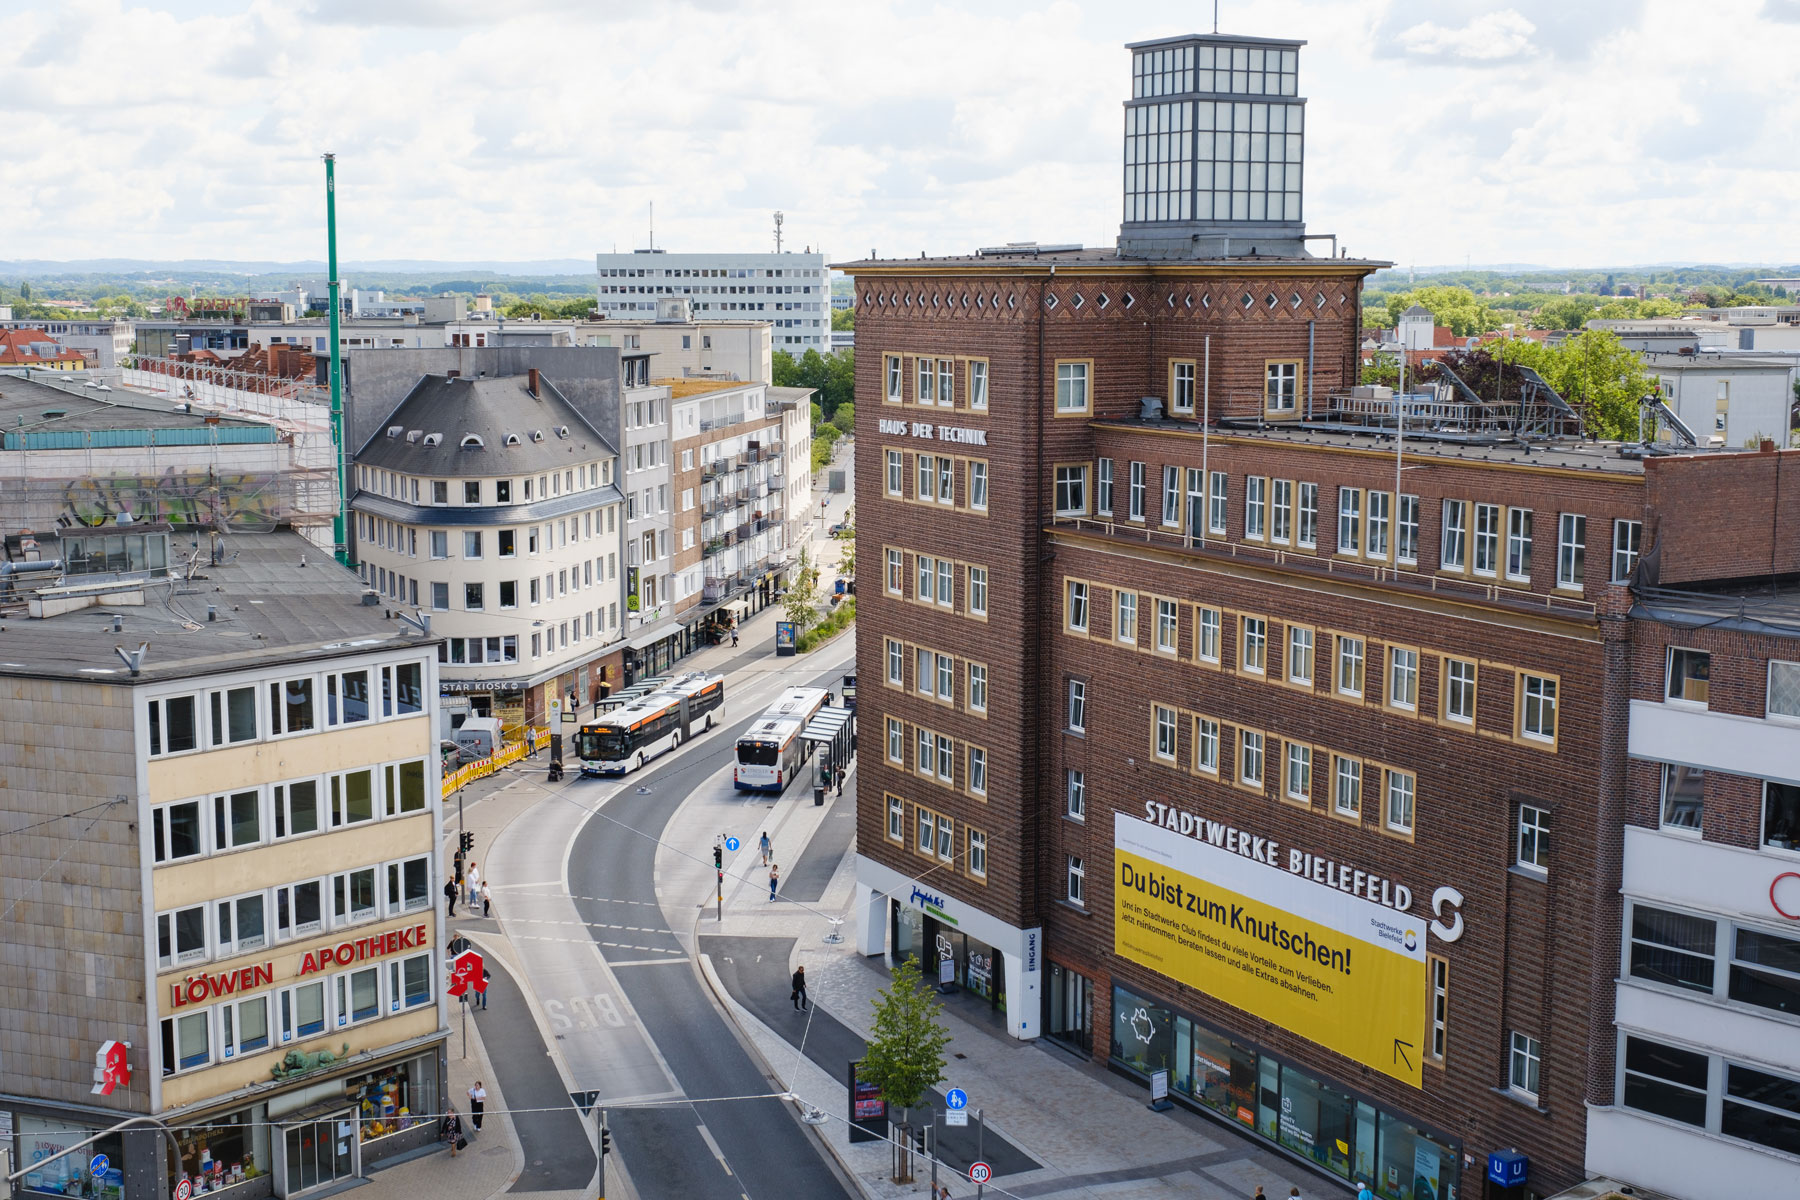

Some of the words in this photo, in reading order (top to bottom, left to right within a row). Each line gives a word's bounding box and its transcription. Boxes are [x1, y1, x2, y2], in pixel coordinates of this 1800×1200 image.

[879, 419, 908, 436] HAUS
[912, 422, 934, 439] DER
[938, 425, 988, 446] TECHNIK
[442, 683, 470, 691] STAR
[475, 682, 507, 690] KIOSK
[1145, 800, 1280, 867] STADTWERKE
[1289, 848, 1413, 911] BIELEFELD
[1122, 862, 1146, 894] Du
[1149, 872, 1183, 908] bist
[1186, 892, 1226, 926] zum
[1230, 903, 1351, 975] Knutschen!
[1370, 918, 1403, 936] Stadtwerke
[1378, 930, 1403, 944] Bielefeld
[1028, 933, 1036, 972] EINGANG
[1121, 912, 1135, 925] Jetzt
[1136, 919, 1177, 943] reinkommen,
[1177, 934, 1204, 953] beraten
[1204, 946, 1226, 962] lassen
[1227, 957, 1241, 969] und
[1241, 962, 1254, 974] alle
[1255, 967, 1279, 985] Extras
[1280, 979, 1318, 1002] absahnen.
[1134, 904, 1142, 914] im
[1143, 908, 1180, 930] Stadtwerke
[1181, 923, 1197, 937] Club
[1197, 929, 1221, 947] findest
[1222, 941, 1231, 951] du
[1232, 945, 1249, 958] viele
[1250, 951, 1277, 970] Vorteile
[1278, 965, 1294, 977] zum
[1295, 969, 1334, 994] Verlieben.
[171, 961, 273, 1008] LÖWEN
[297, 924, 428, 976] APOTHEKE
[973, 1168, 987, 1179] 30
[1494, 1160, 1502, 1173] U
[1513, 1162, 1522, 1175] U
[179, 1185, 189, 1198] 30
